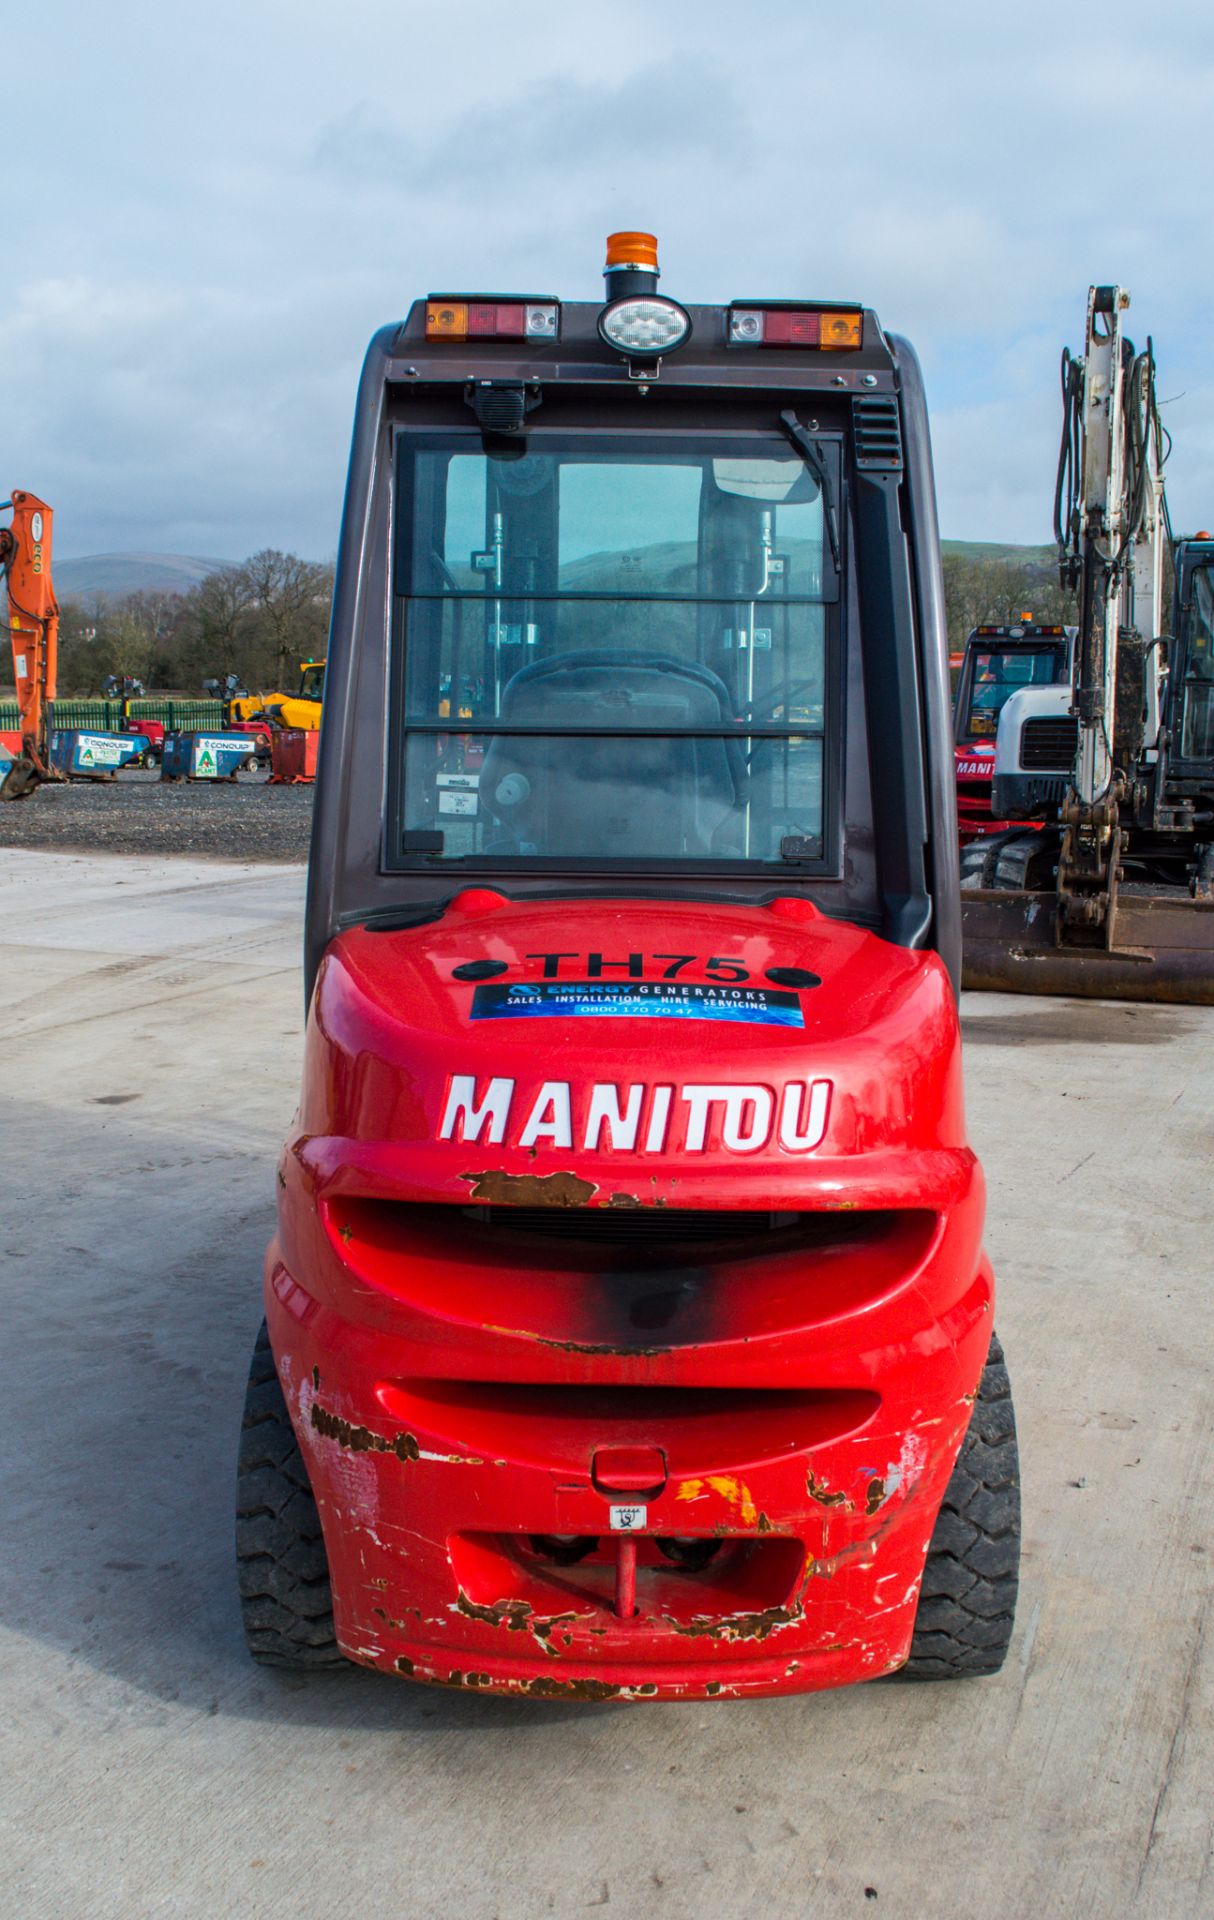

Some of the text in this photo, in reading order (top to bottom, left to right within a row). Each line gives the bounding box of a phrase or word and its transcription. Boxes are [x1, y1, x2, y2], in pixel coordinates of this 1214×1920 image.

[210, 742, 250, 750] CONQUIP
[525, 952, 751, 982] TH75
[547, 985, 766, 1001] ENERGY GENERATORS
[506, 995, 768, 1011] SALES INSTALLATION HIRE SERVICING
[623, 1006, 649, 1014] 170
[654, 1006, 672, 1014] 70
[439, 1073, 829, 1153] MANITOU
